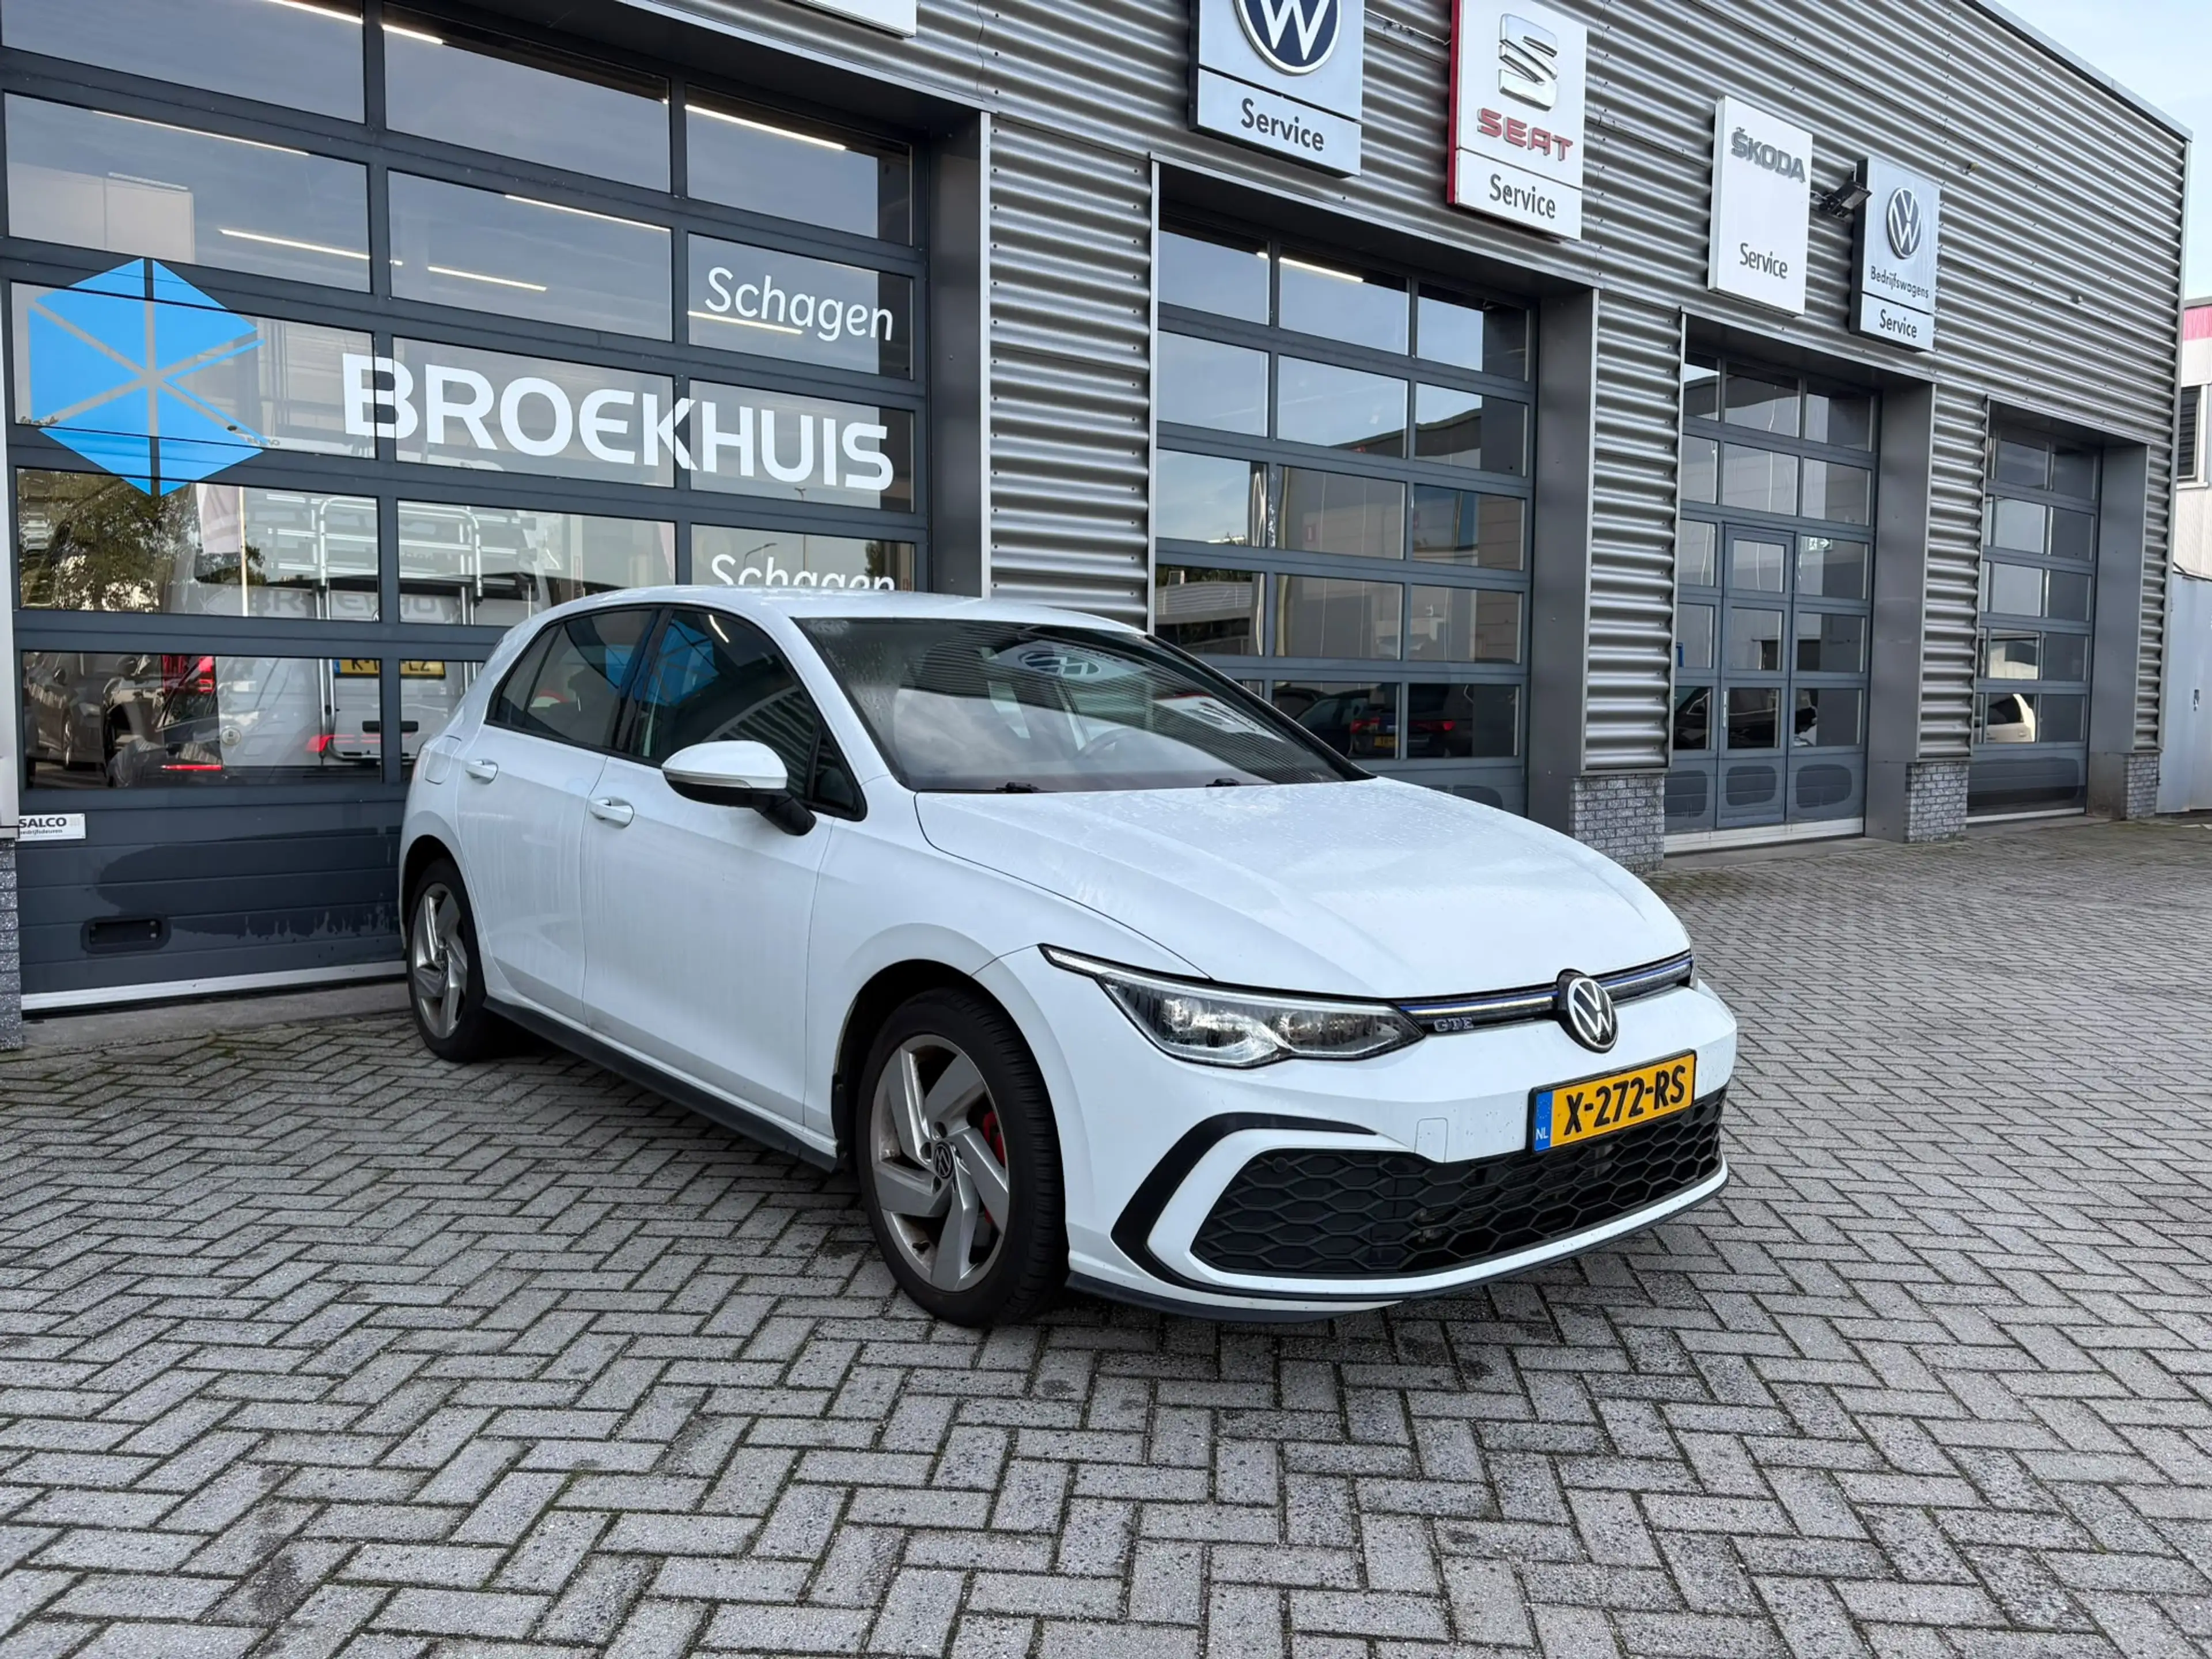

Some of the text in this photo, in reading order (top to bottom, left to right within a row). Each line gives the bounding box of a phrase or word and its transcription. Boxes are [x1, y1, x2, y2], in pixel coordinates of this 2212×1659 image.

[1240, 97, 1324, 152] Service
[1476, 107, 1574, 162] SEAT
[1730, 126, 1806, 184] ŠKODA
[1488, 173, 1556, 219] Service
[1739, 242, 1788, 279] Service
[1870, 265, 1930, 299] Bedrijfswagens
[704, 266, 893, 343] Schagen
[1879, 308, 1918, 339] Service
[342, 352, 895, 491] BROEKHUIS
[19, 817, 67, 828] SALCO
[1433, 1017, 1475, 1033] GTE
[1563, 1065, 1686, 1137] X-272-RS
[1535, 1128, 1549, 1142] NL
